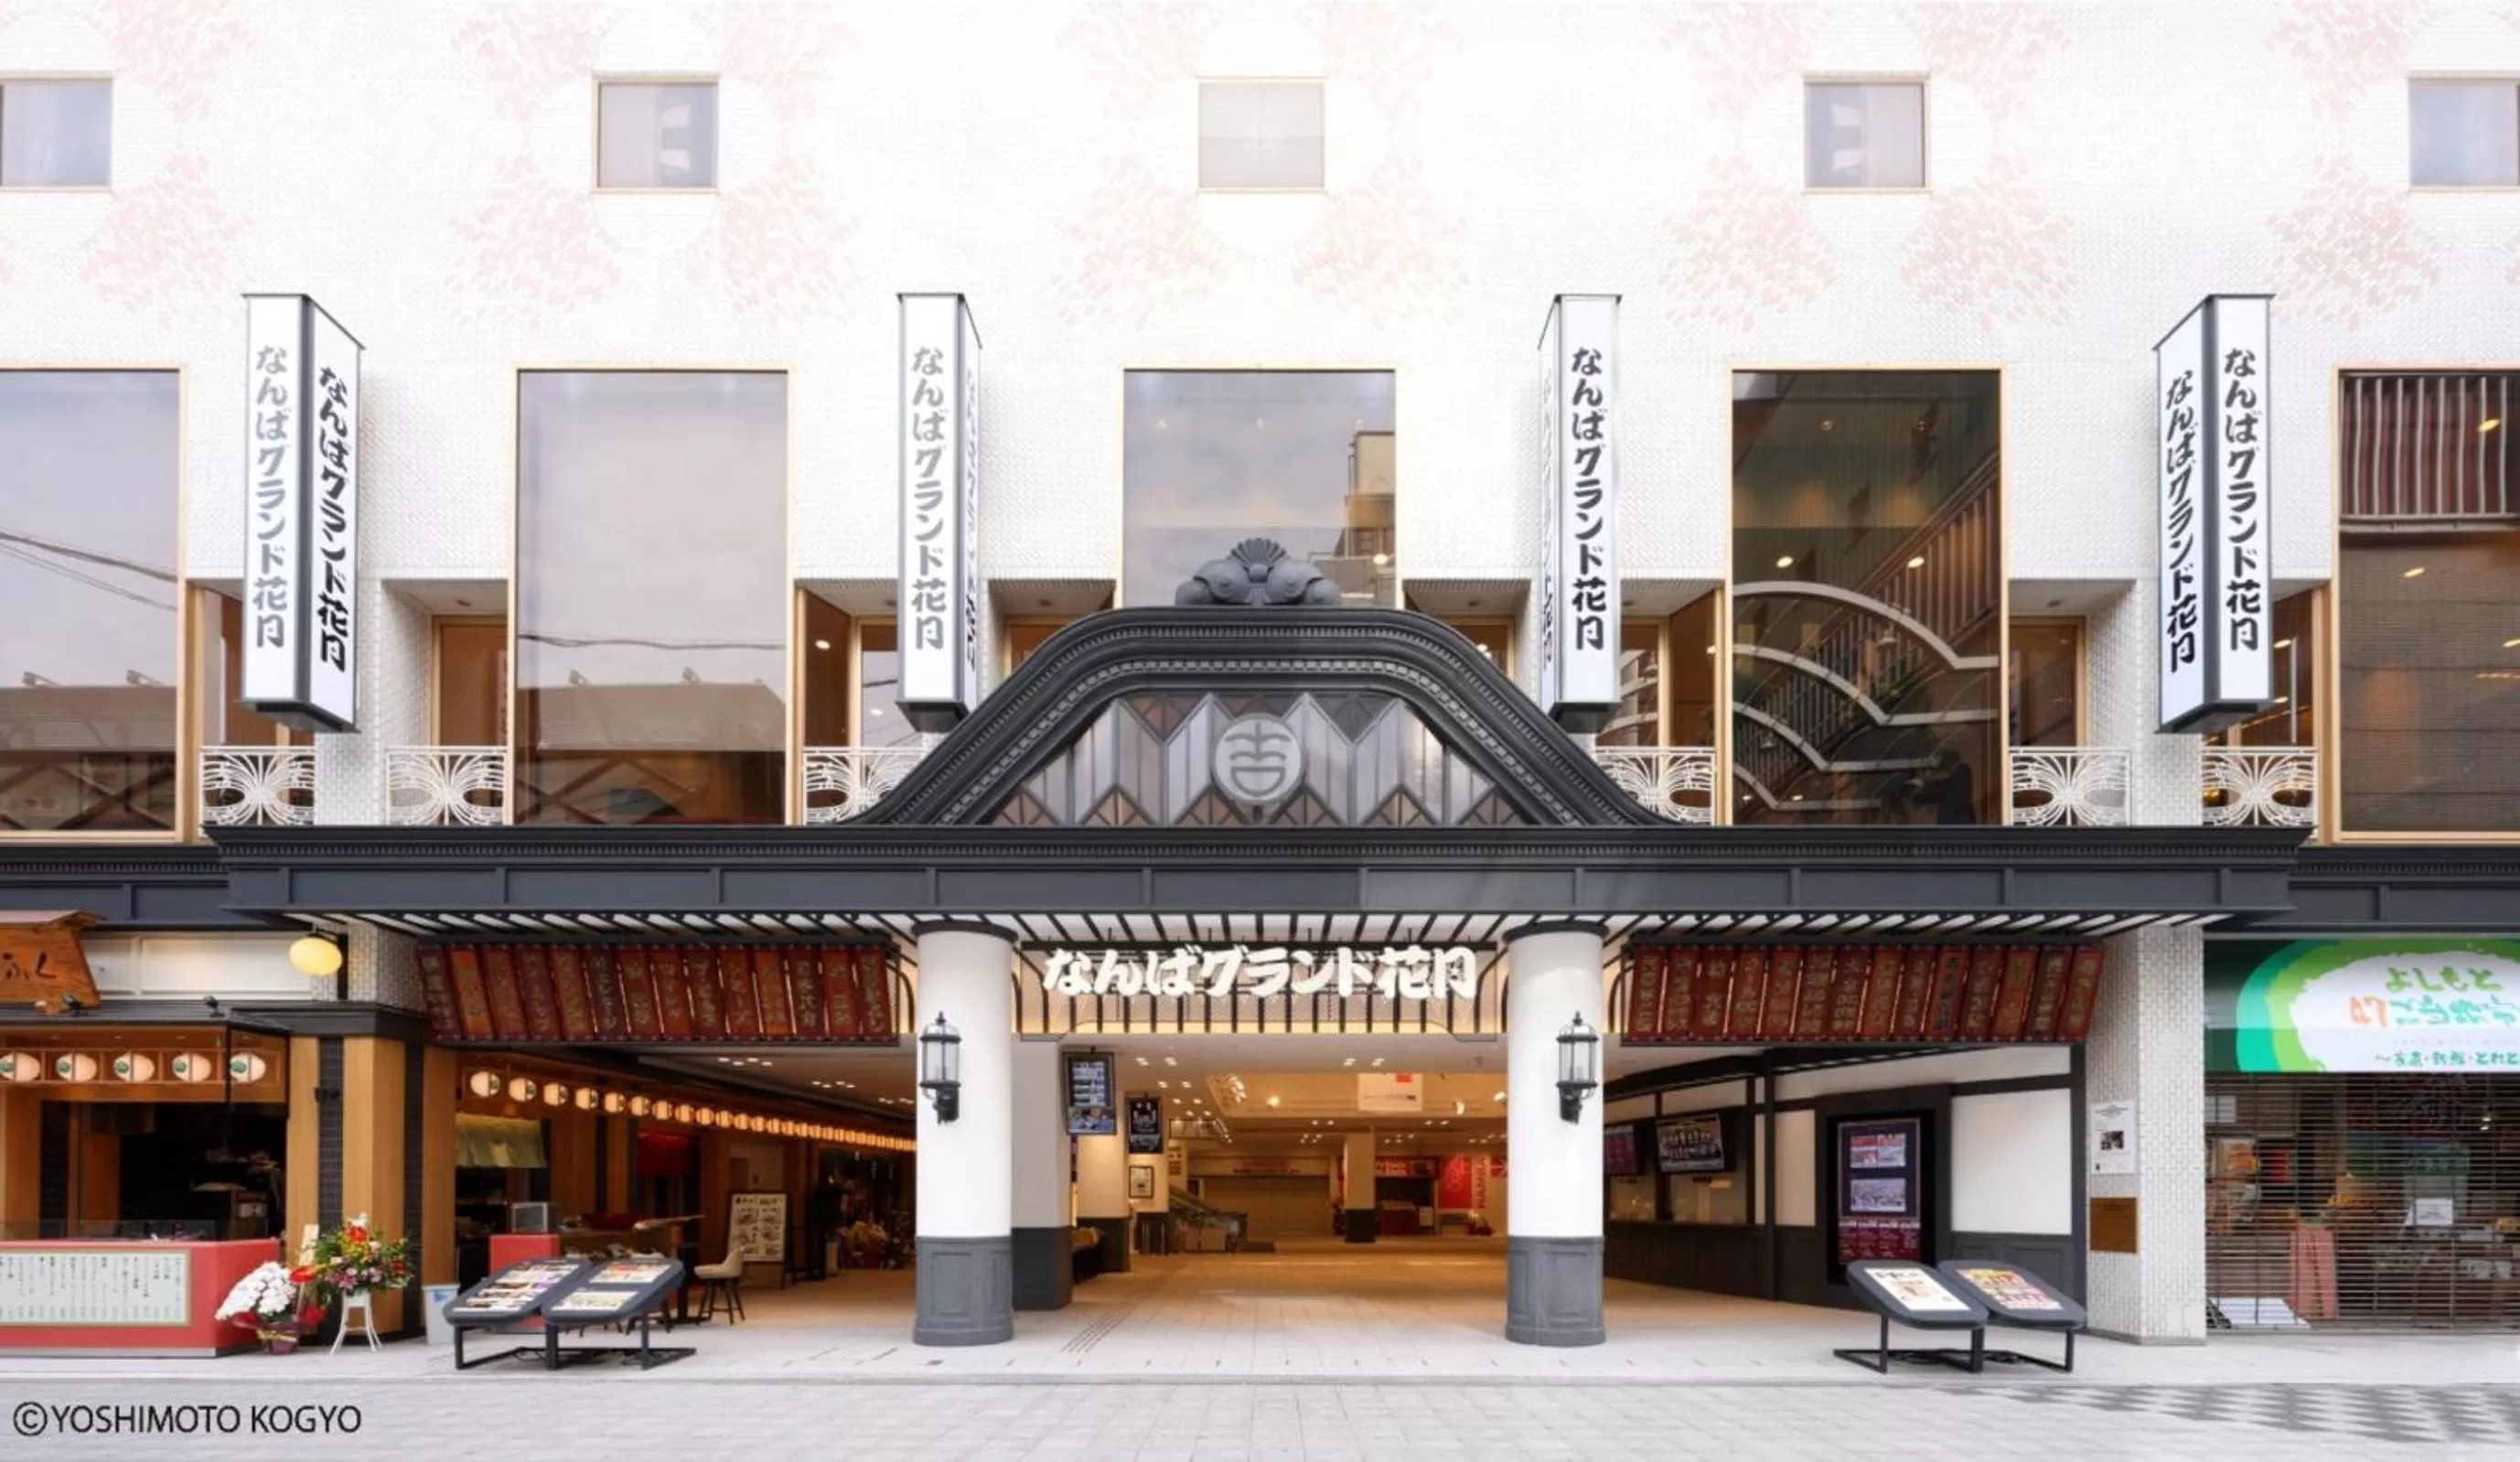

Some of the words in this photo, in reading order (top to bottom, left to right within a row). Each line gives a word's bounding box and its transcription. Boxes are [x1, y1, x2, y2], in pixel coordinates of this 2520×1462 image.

[252, 345, 290, 649] なんばグランド花月
[318, 367, 349, 673] なんばグランド花月
[911, 346, 949, 651] なんばグランド花月
[1571, 347, 1608, 650] なんばグランド花月
[2165, 369, 2199, 673] なんばグランド花月
[2225, 348, 2263, 652] なんばグランド花月
[1043, 945, 1477, 999] なんばグランド花月
[2385, 965, 2503, 993] よしもと
